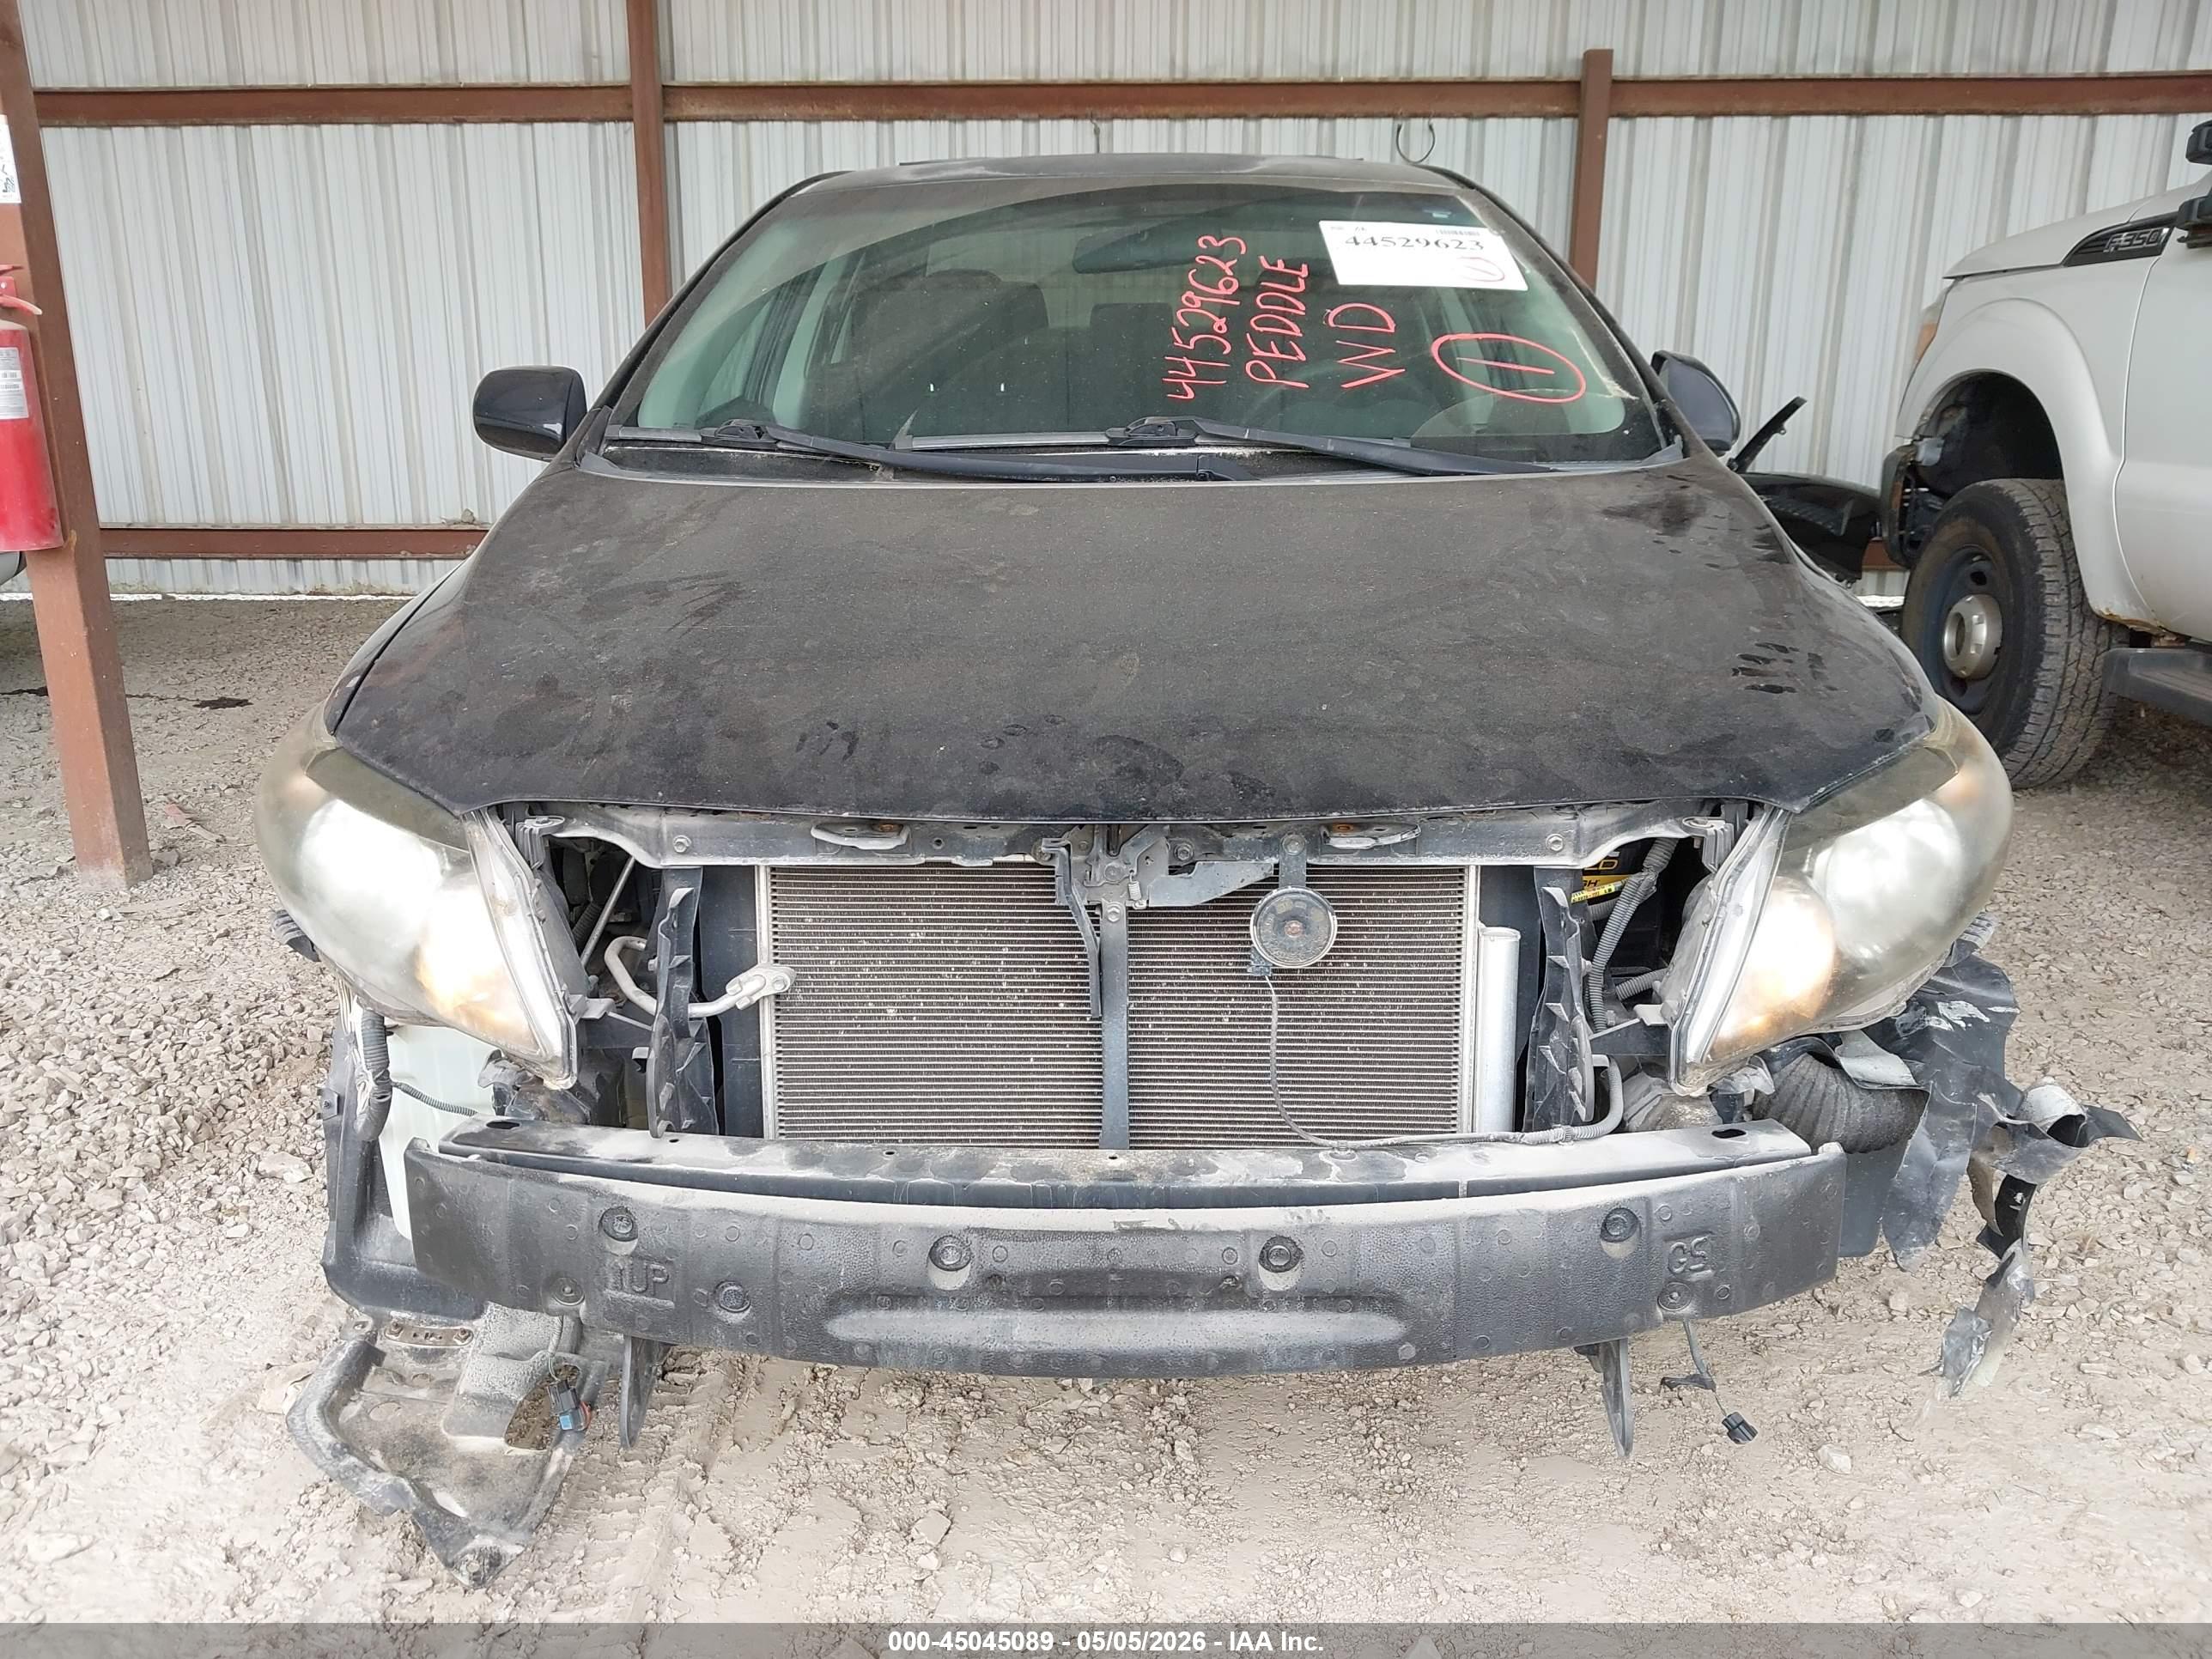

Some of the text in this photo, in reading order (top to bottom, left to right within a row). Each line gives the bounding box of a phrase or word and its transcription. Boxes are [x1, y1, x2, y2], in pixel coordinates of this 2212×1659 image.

[1344, 235, 1485, 251] 44529623
[1161, 234, 1248, 400] 44529623
[1245, 255, 1310, 388] PEDDLE
[1327, 302, 1406, 388] WD
